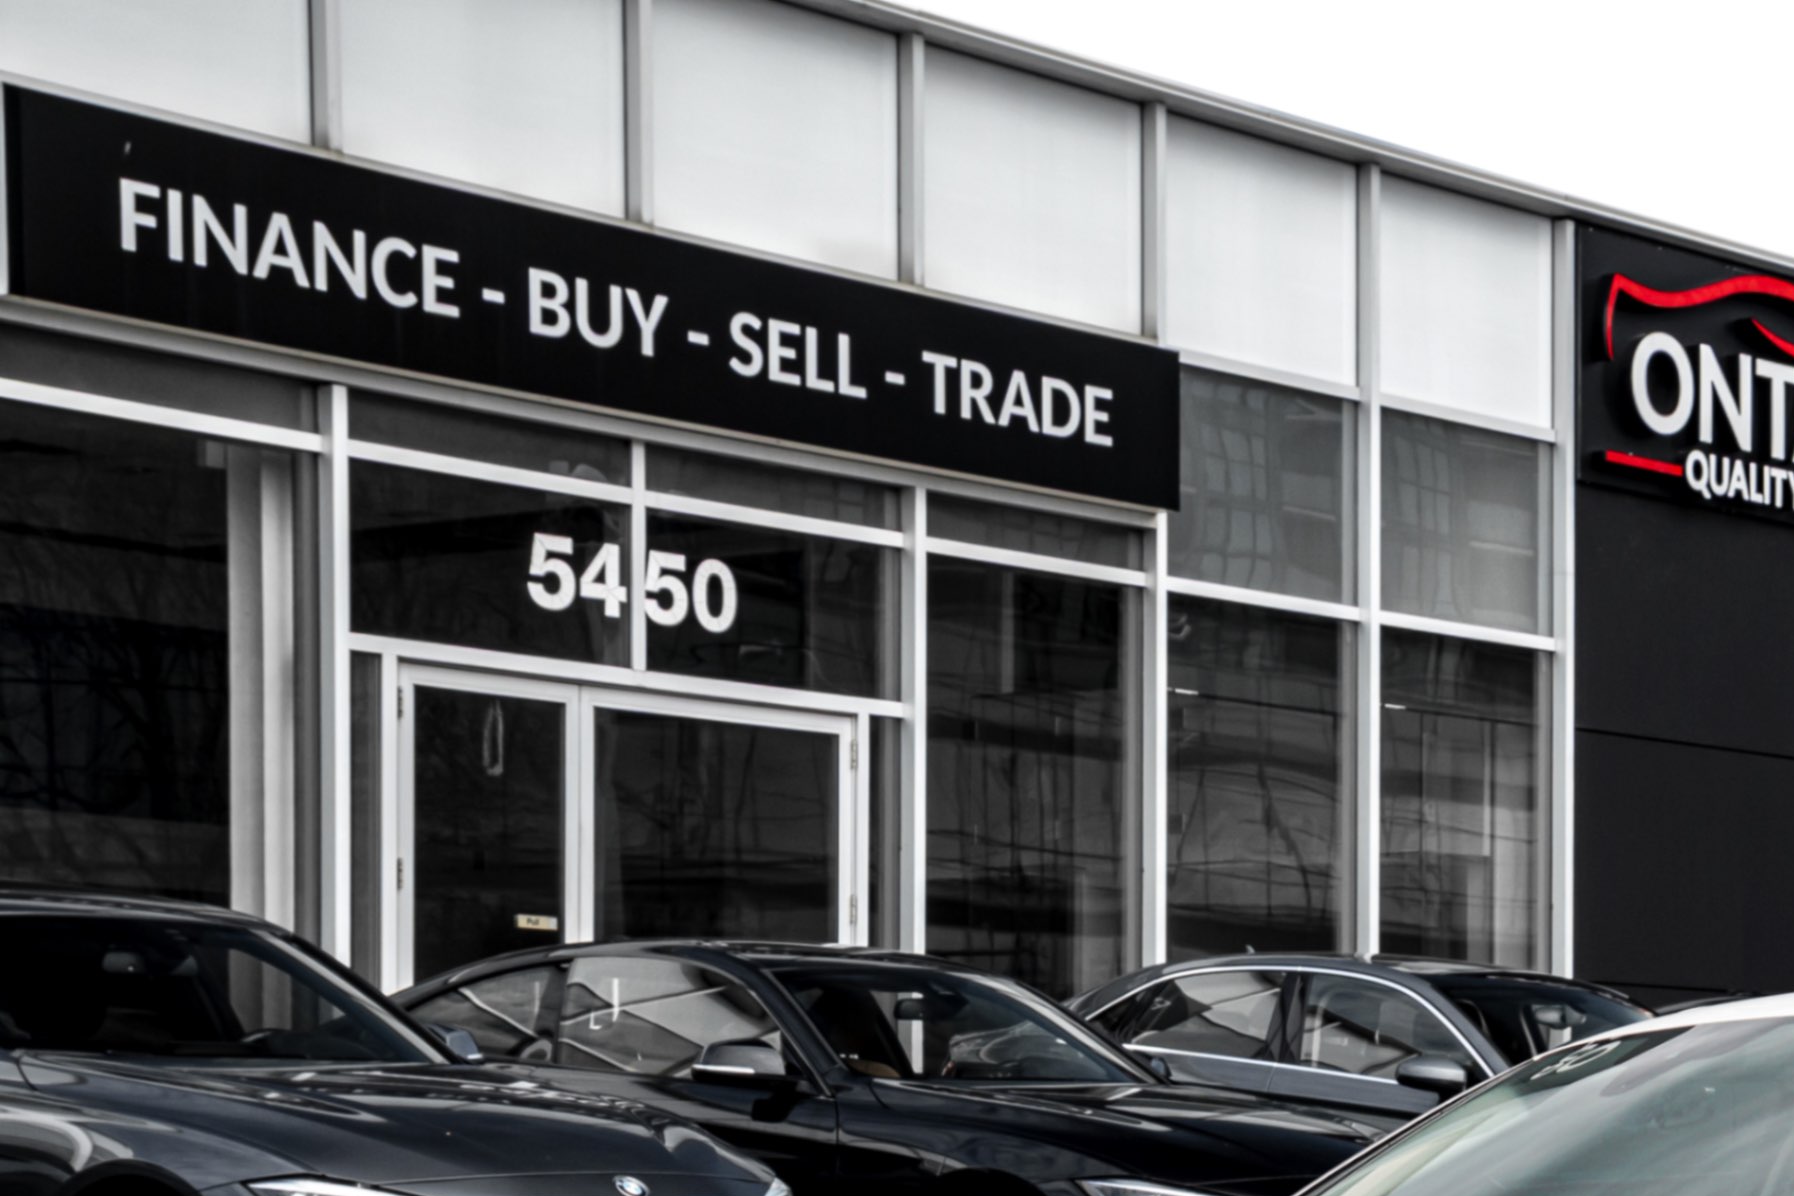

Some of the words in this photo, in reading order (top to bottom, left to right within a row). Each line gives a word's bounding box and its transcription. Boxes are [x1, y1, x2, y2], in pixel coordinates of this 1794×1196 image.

[119, 178, 460, 318] FINANCE
[528, 267, 669, 357] BUY
[729, 312, 867, 399] SELL
[921, 350, 1113, 447] TRADE
[526, 531, 738, 634] 5450
